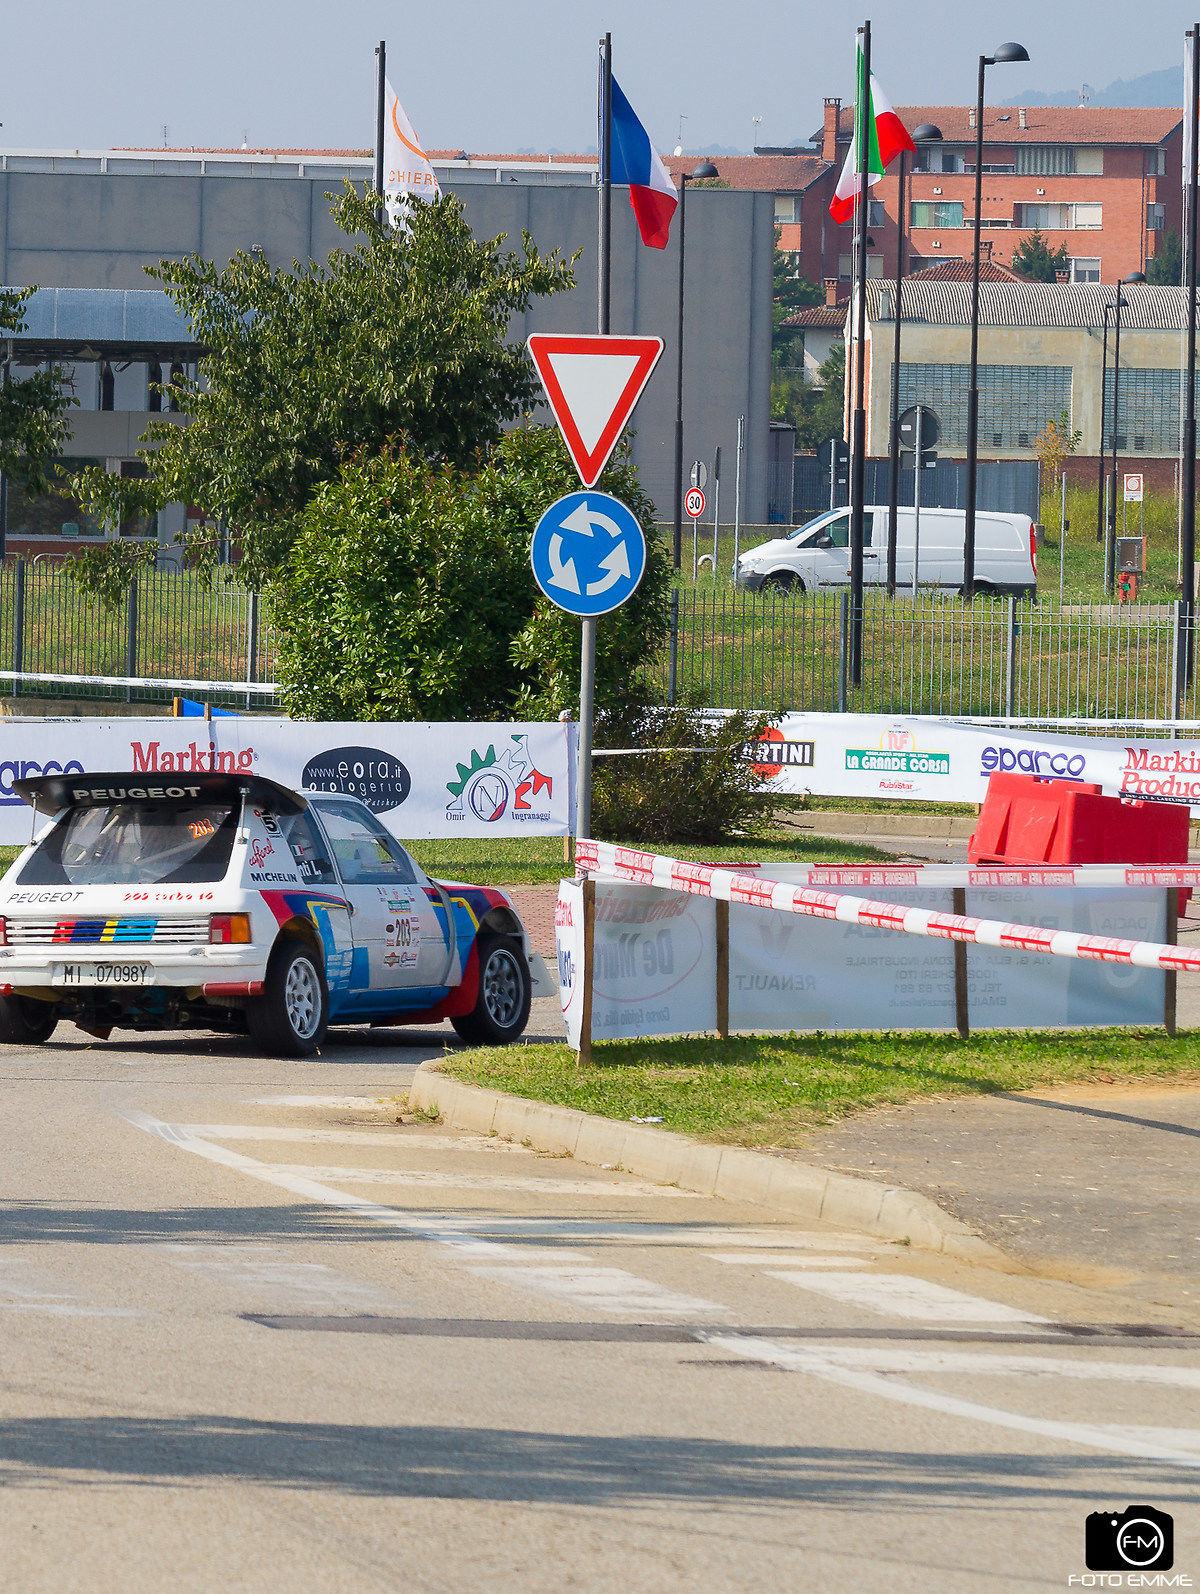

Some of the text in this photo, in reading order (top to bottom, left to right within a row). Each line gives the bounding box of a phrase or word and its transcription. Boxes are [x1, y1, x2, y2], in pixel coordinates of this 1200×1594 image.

[689, 496, 701, 509] 30
[846, 755, 949, 773] LA GRANDE CORSA
[980, 746, 1086, 777] sparco
[1124, 747, 1200, 774] Marki
[307, 761, 402, 779] www.eora.it
[71, 786, 201, 801] PEUGEOT
[309, 780, 402, 797] orologeria
[445, 811, 466, 821] Omir
[511, 811, 551, 822] Ingranaggi
[188, 818, 215, 839] 203
[250, 872, 298, 883] MICHELIN
[6, 891, 85, 904] PEUGEOT
[63, 965, 148, 983] MI 07098Y
